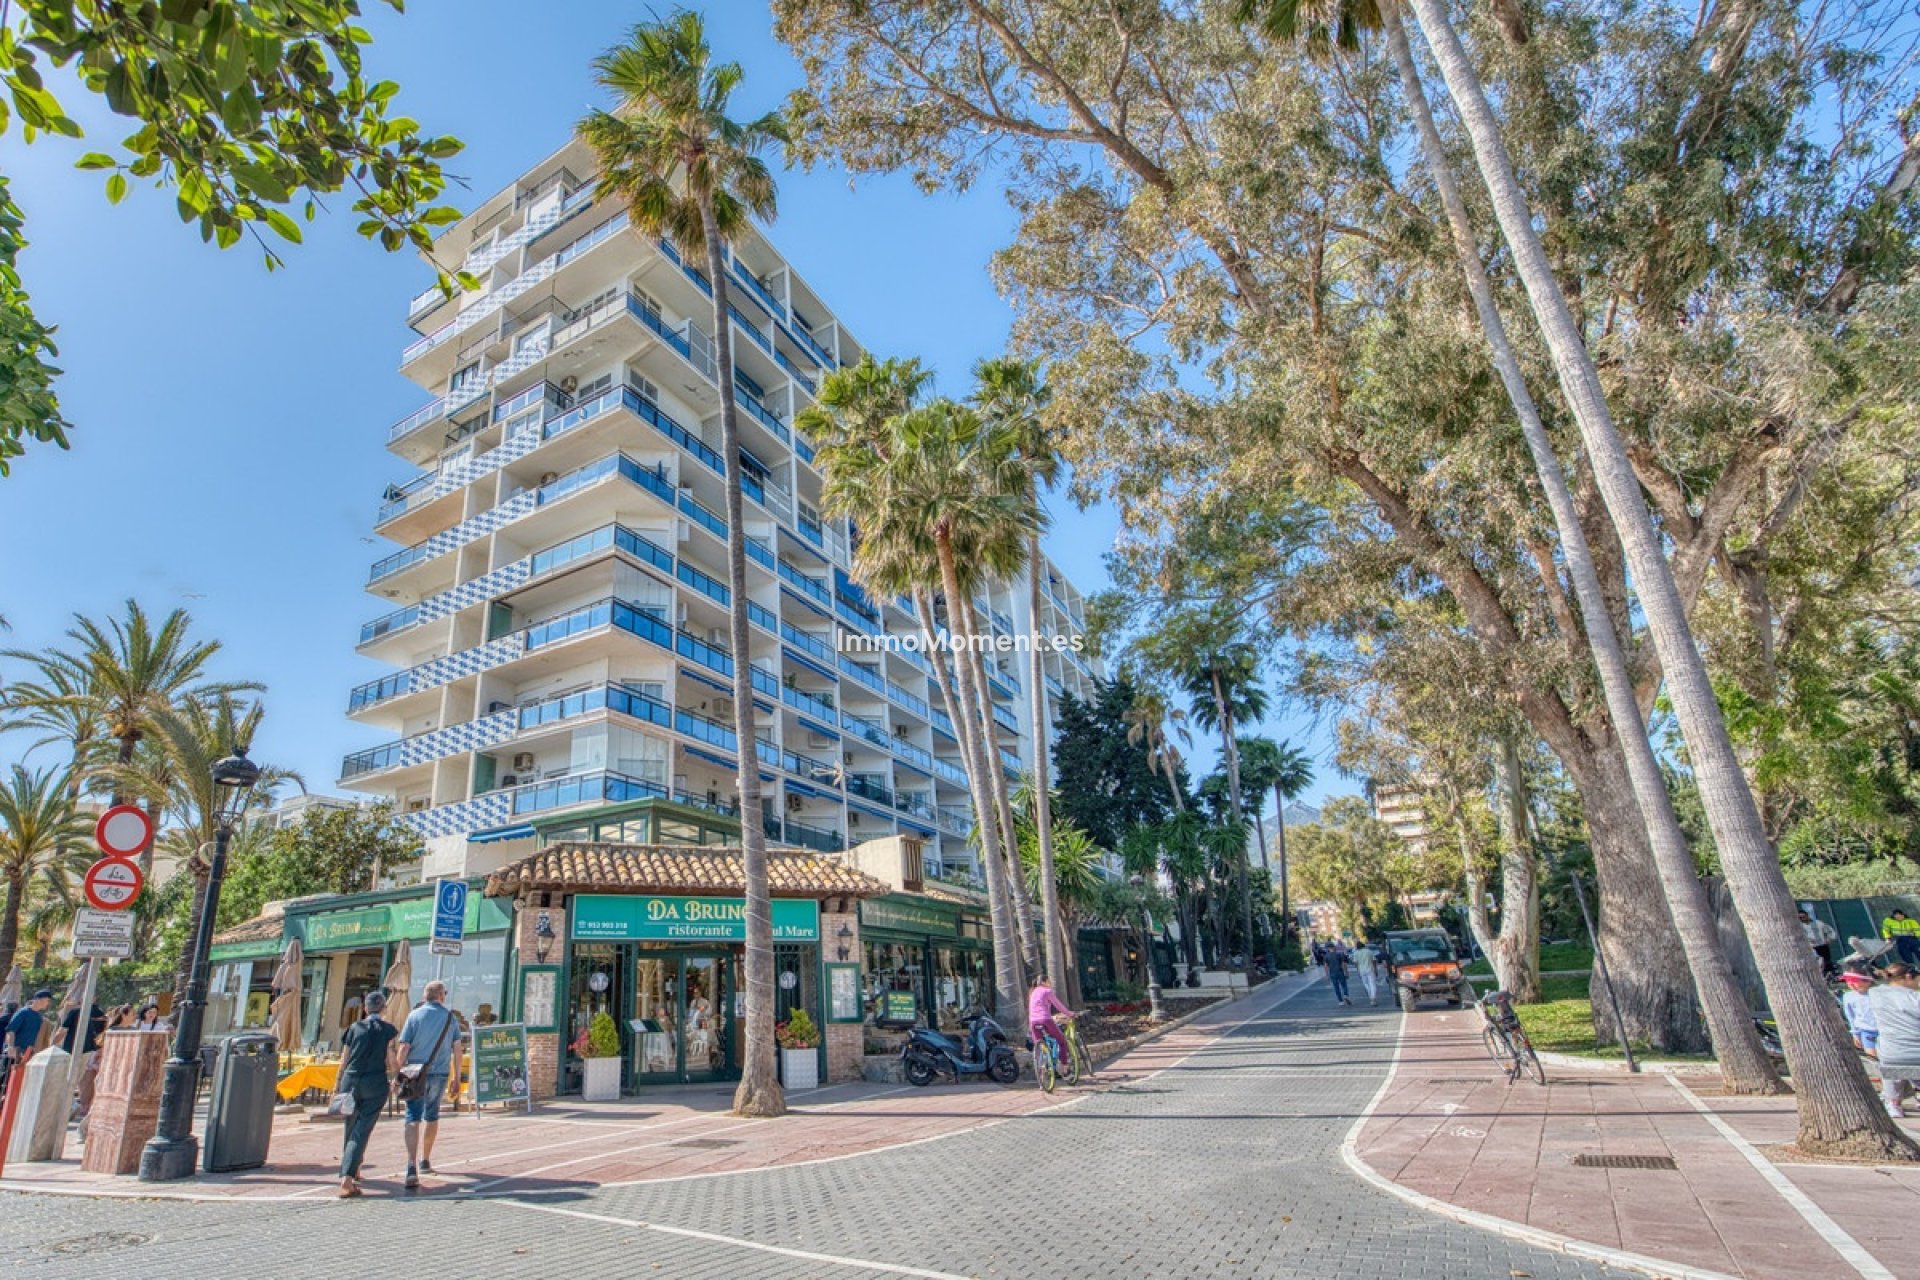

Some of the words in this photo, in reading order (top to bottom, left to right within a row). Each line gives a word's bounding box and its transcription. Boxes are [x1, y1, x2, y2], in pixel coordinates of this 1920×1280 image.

[684, 900, 747, 921] BRUN
[668, 924, 733, 937] ristorante
[785, 926, 814, 937] Mare
